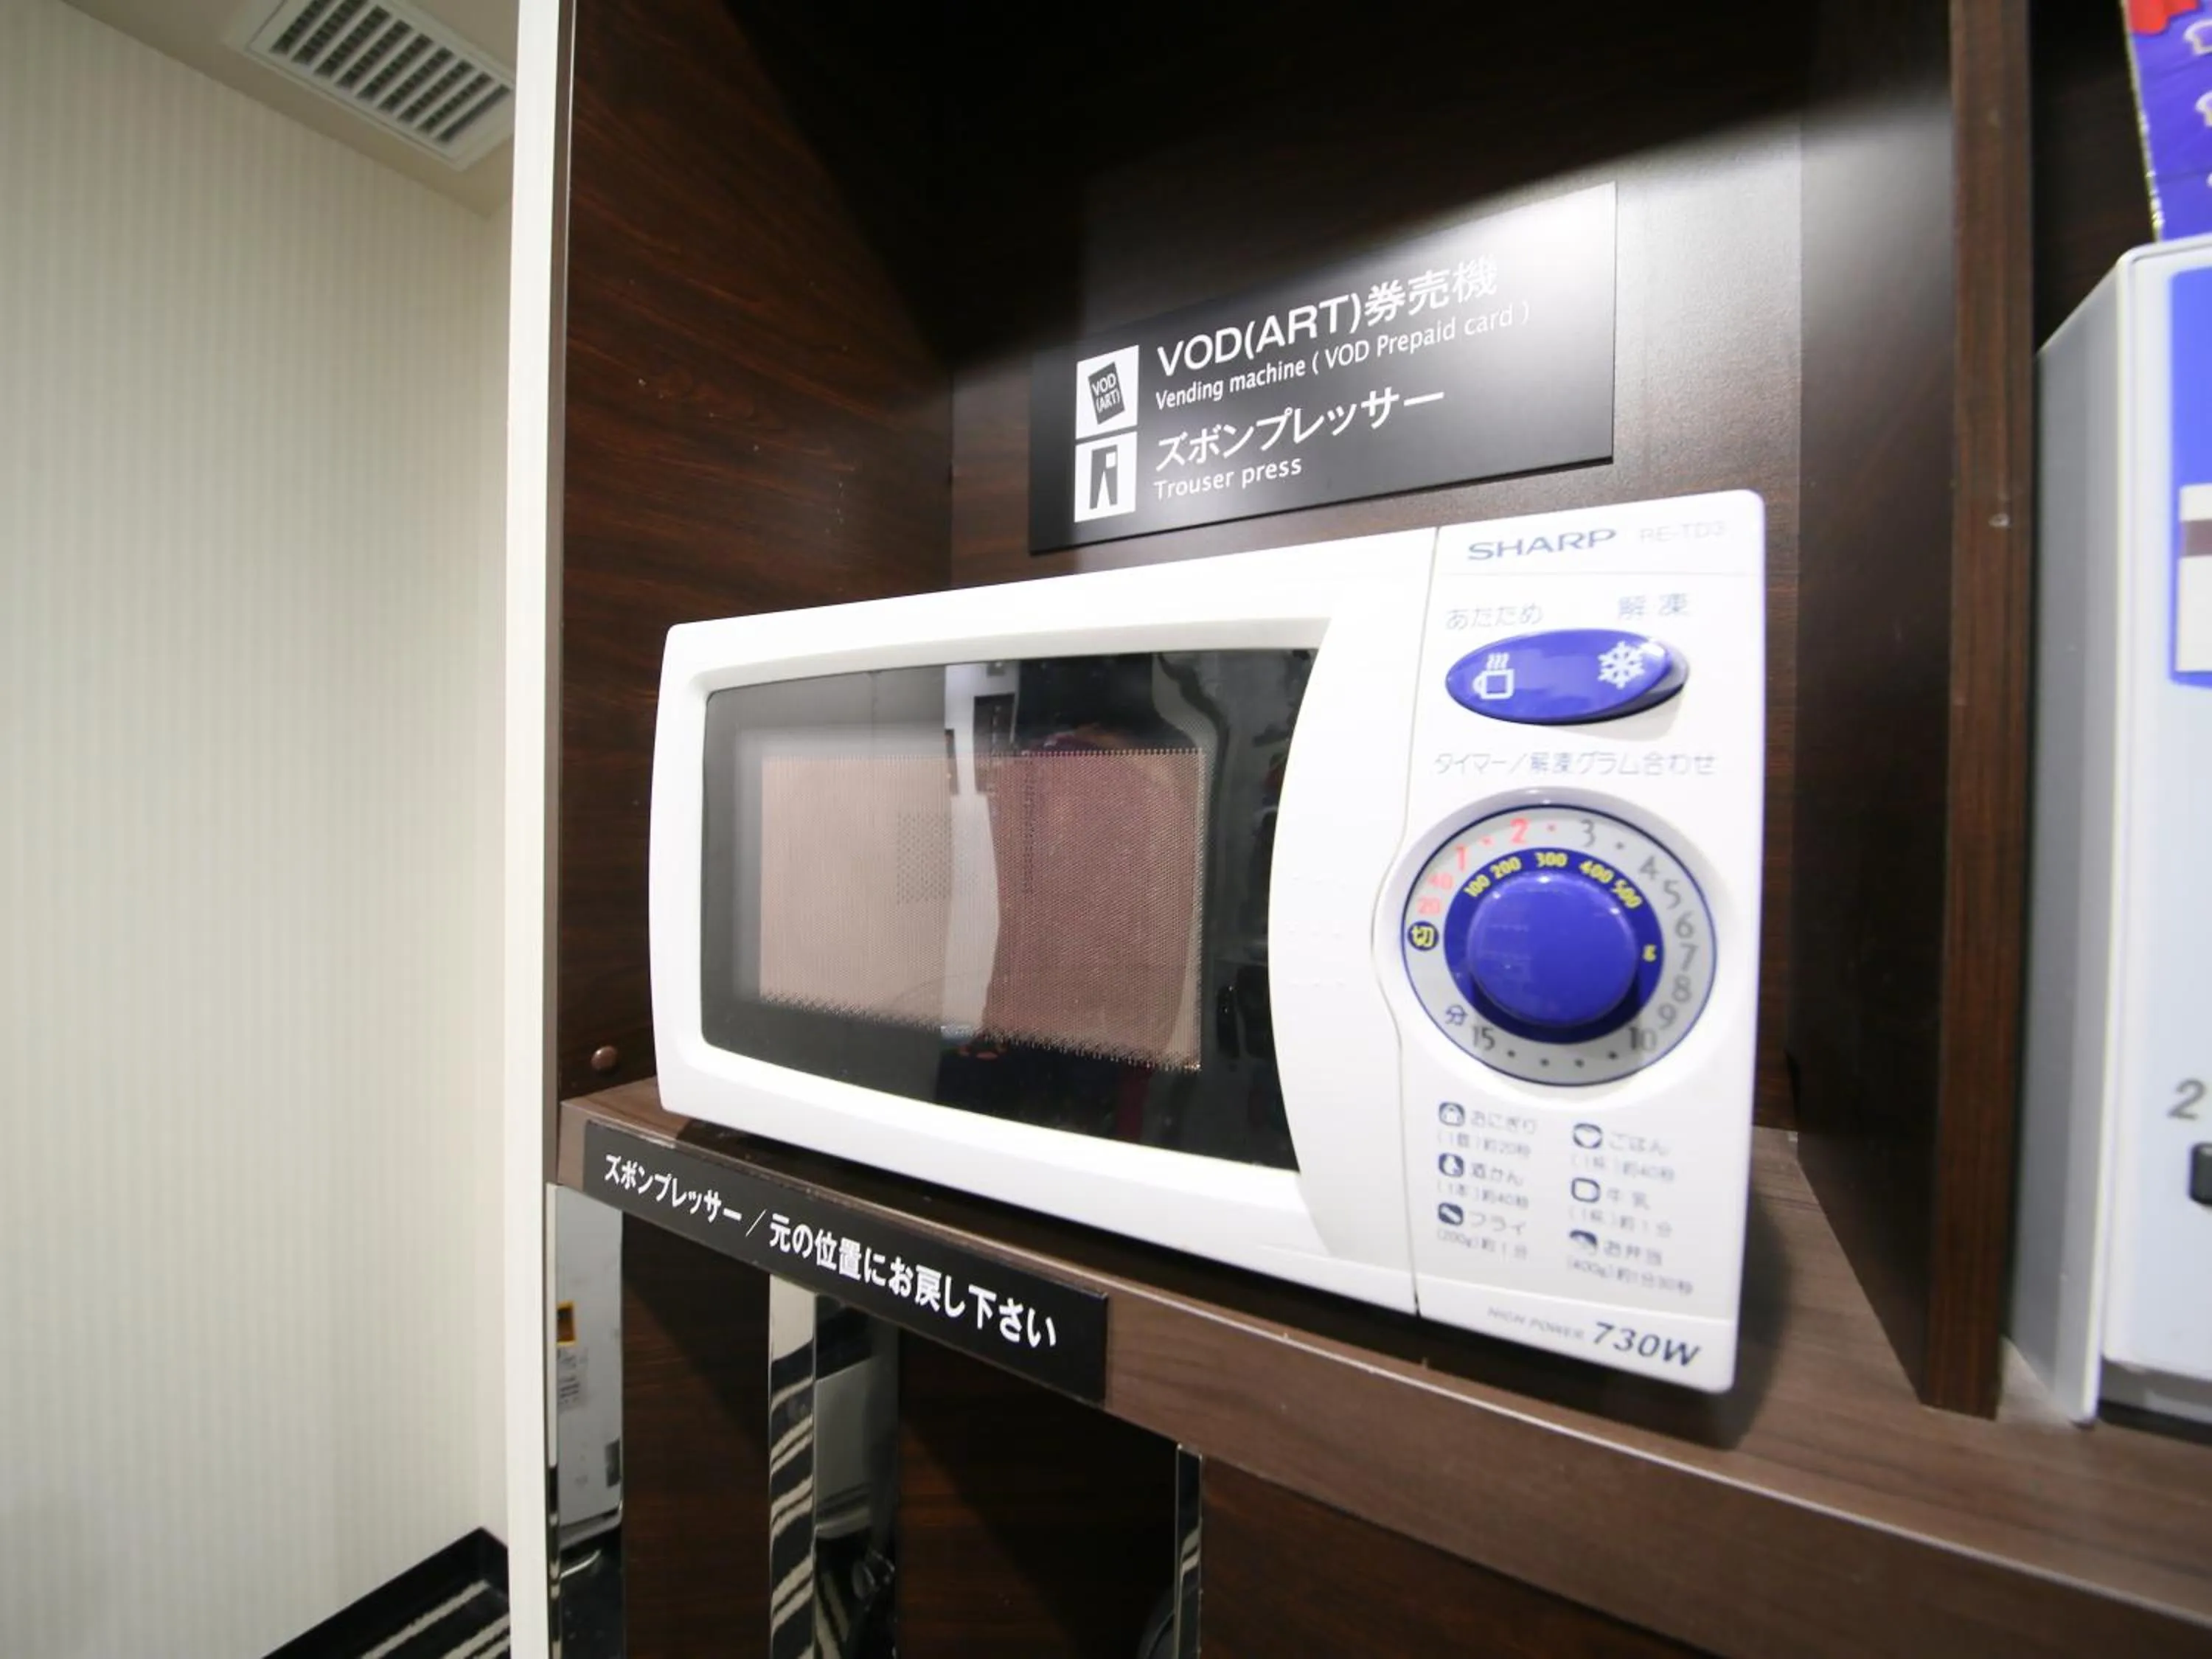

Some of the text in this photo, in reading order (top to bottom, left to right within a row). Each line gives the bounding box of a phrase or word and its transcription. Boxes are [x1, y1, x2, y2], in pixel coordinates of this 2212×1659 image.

[1157, 256, 1498, 377] VOD(ART)券売機
[1156, 378, 1223, 410] Vending
[1229, 359, 1306, 392] machine
[1377, 324, 1455, 364] Prepaid
[1464, 304, 1514, 337] card
[1091, 372, 1118, 396] VOD
[1095, 389, 1121, 414] (ART)
[1155, 387, 1444, 472] ズボンプレッサー
[1154, 456, 1302, 503] Trouser press
[1467, 529, 1617, 561] SHARP
[1445, 603, 1544, 630] あたため
[1510, 818, 1531, 844] 2
[1580, 819, 1597, 847] 3
[1455, 845, 1468, 872] 1
[1489, 856, 1522, 880] 200
[1535, 852, 1567, 868] 300
[1579, 860, 1614, 884] 400
[1639, 855, 1659, 880] 4
[1464, 874, 1491, 898] 100
[1613, 880, 1643, 909] 500
[1663, 880, 1682, 910] 5
[1674, 911, 1694, 939] 6
[1680, 943, 1699, 971] 7
[1672, 975, 1691, 1004] 8
[1656, 1003, 1677, 1031] 9
[1472, 1025, 1496, 1051] 15
[1627, 1025, 1658, 1054] 10
[2166, 1077, 2208, 1120] 2
[604, 1153, 741, 1221] ズボンプレッサー
[769, 1213, 1056, 1349] 元の位置にお戻し下さい
[1593, 1320, 1703, 1368] 730W
